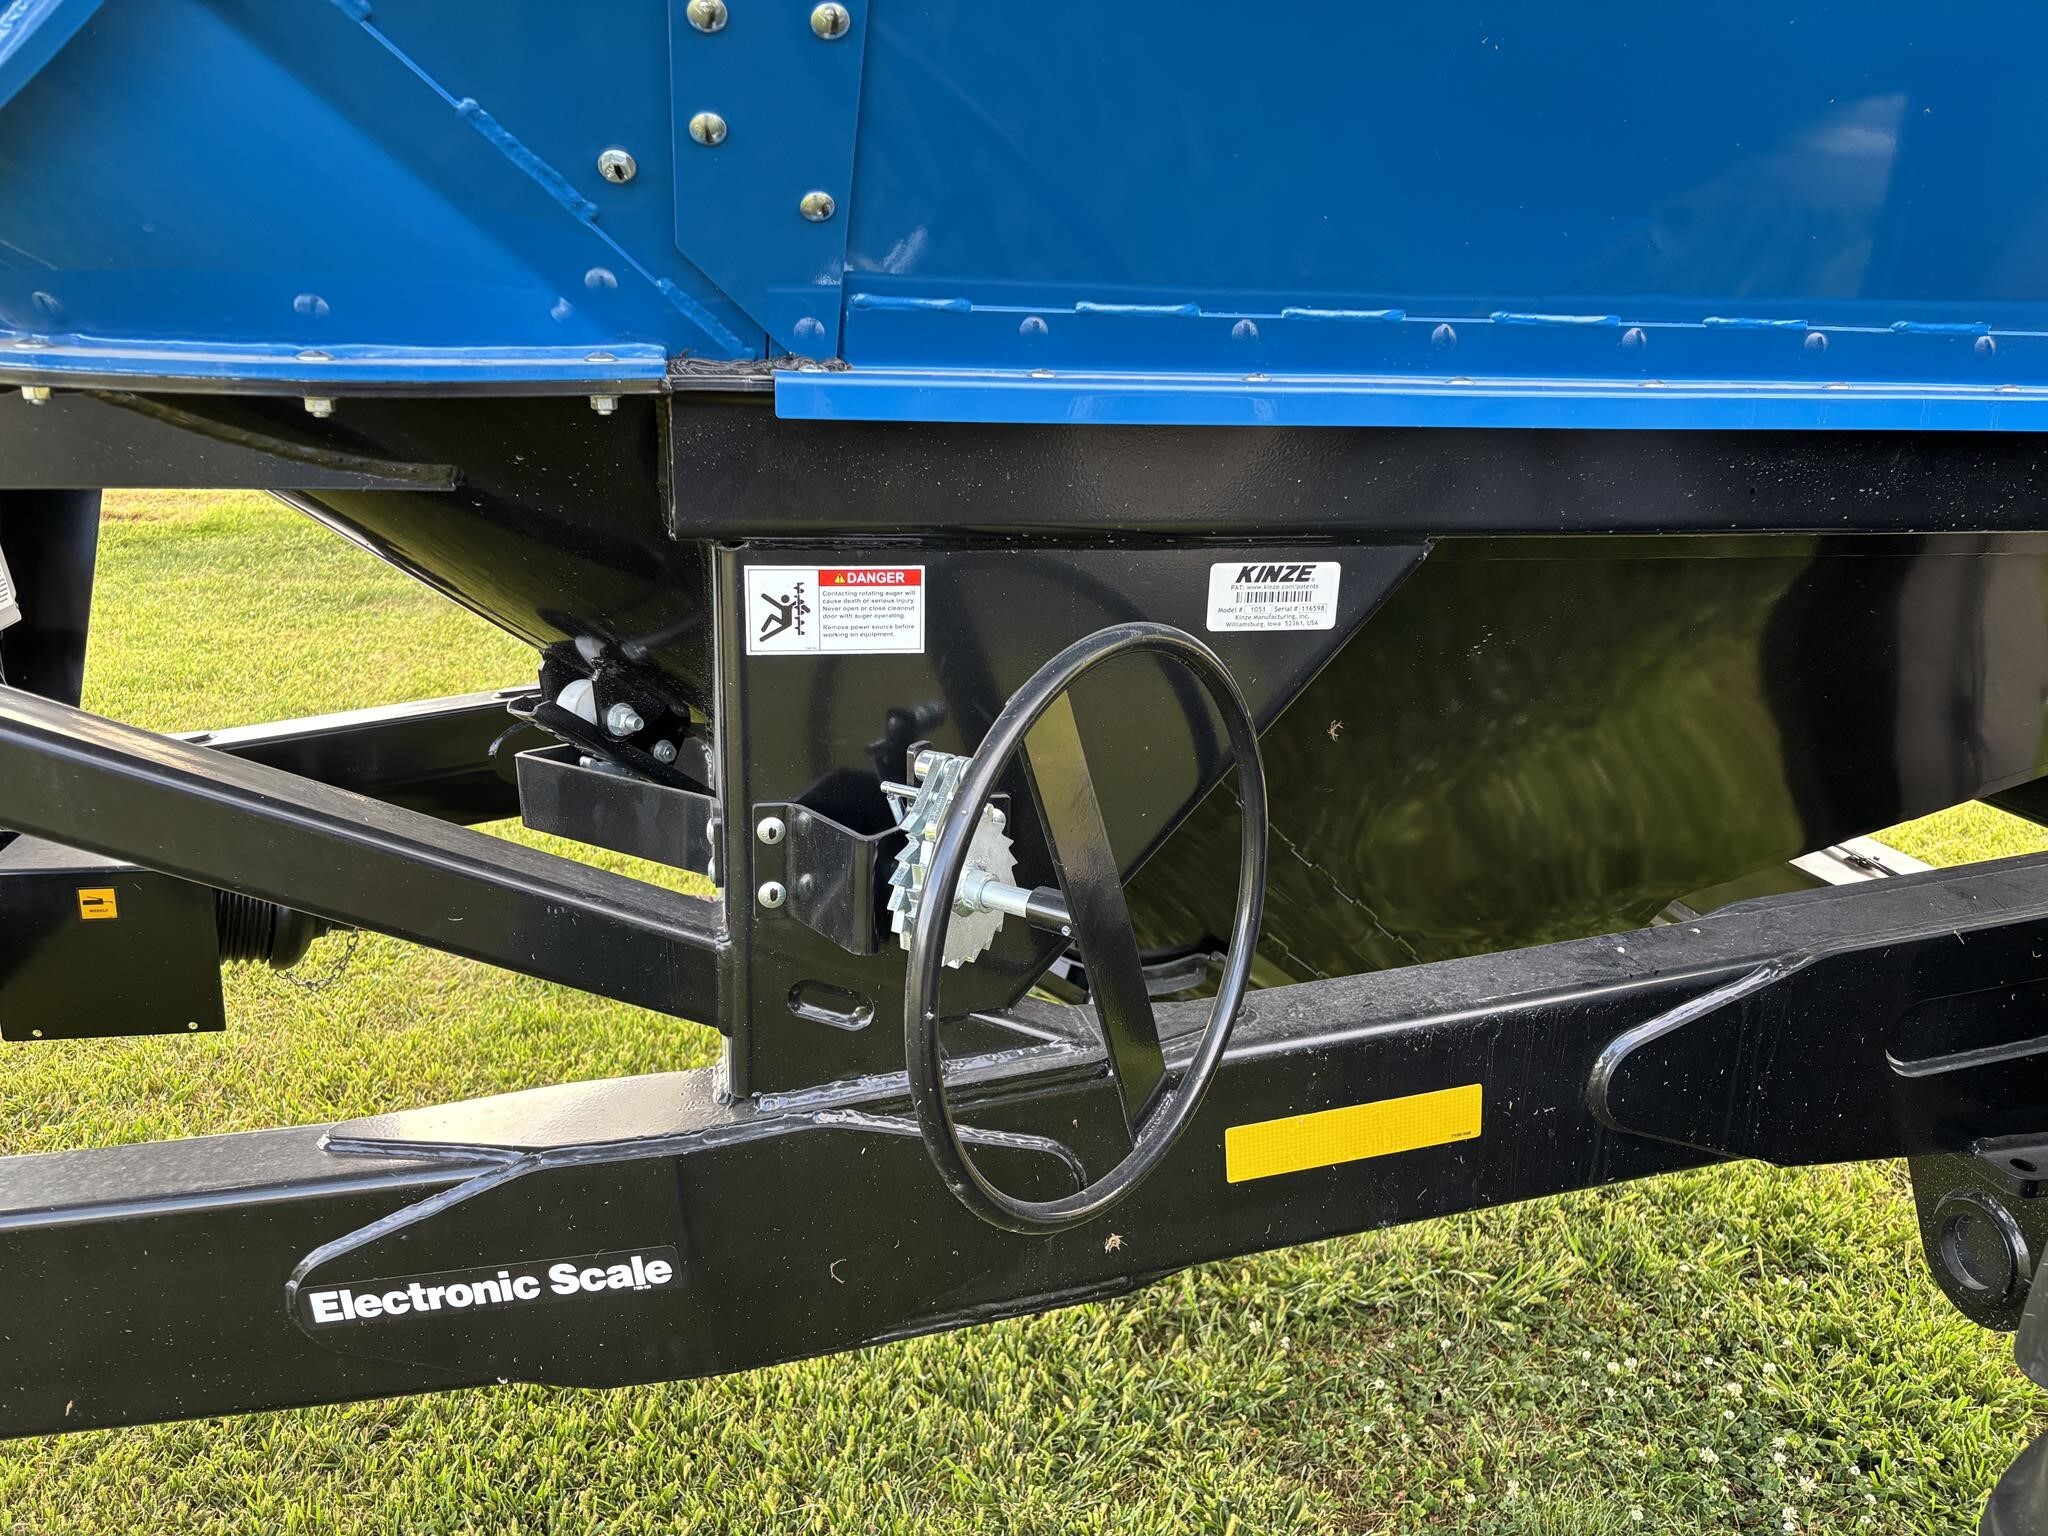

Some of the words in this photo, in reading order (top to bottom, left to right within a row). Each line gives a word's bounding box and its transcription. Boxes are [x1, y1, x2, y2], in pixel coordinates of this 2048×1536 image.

[847, 572, 905, 584] DANGER
[1235, 565, 1317, 583] KINZE
[1218, 606, 1237, 614] Model
[1274, 605, 1293, 613] Serial
[1253, 613, 1298, 621] Manufacturing,
[308, 1270, 541, 1324] Electronic
[548, 1255, 673, 1295] Scale
